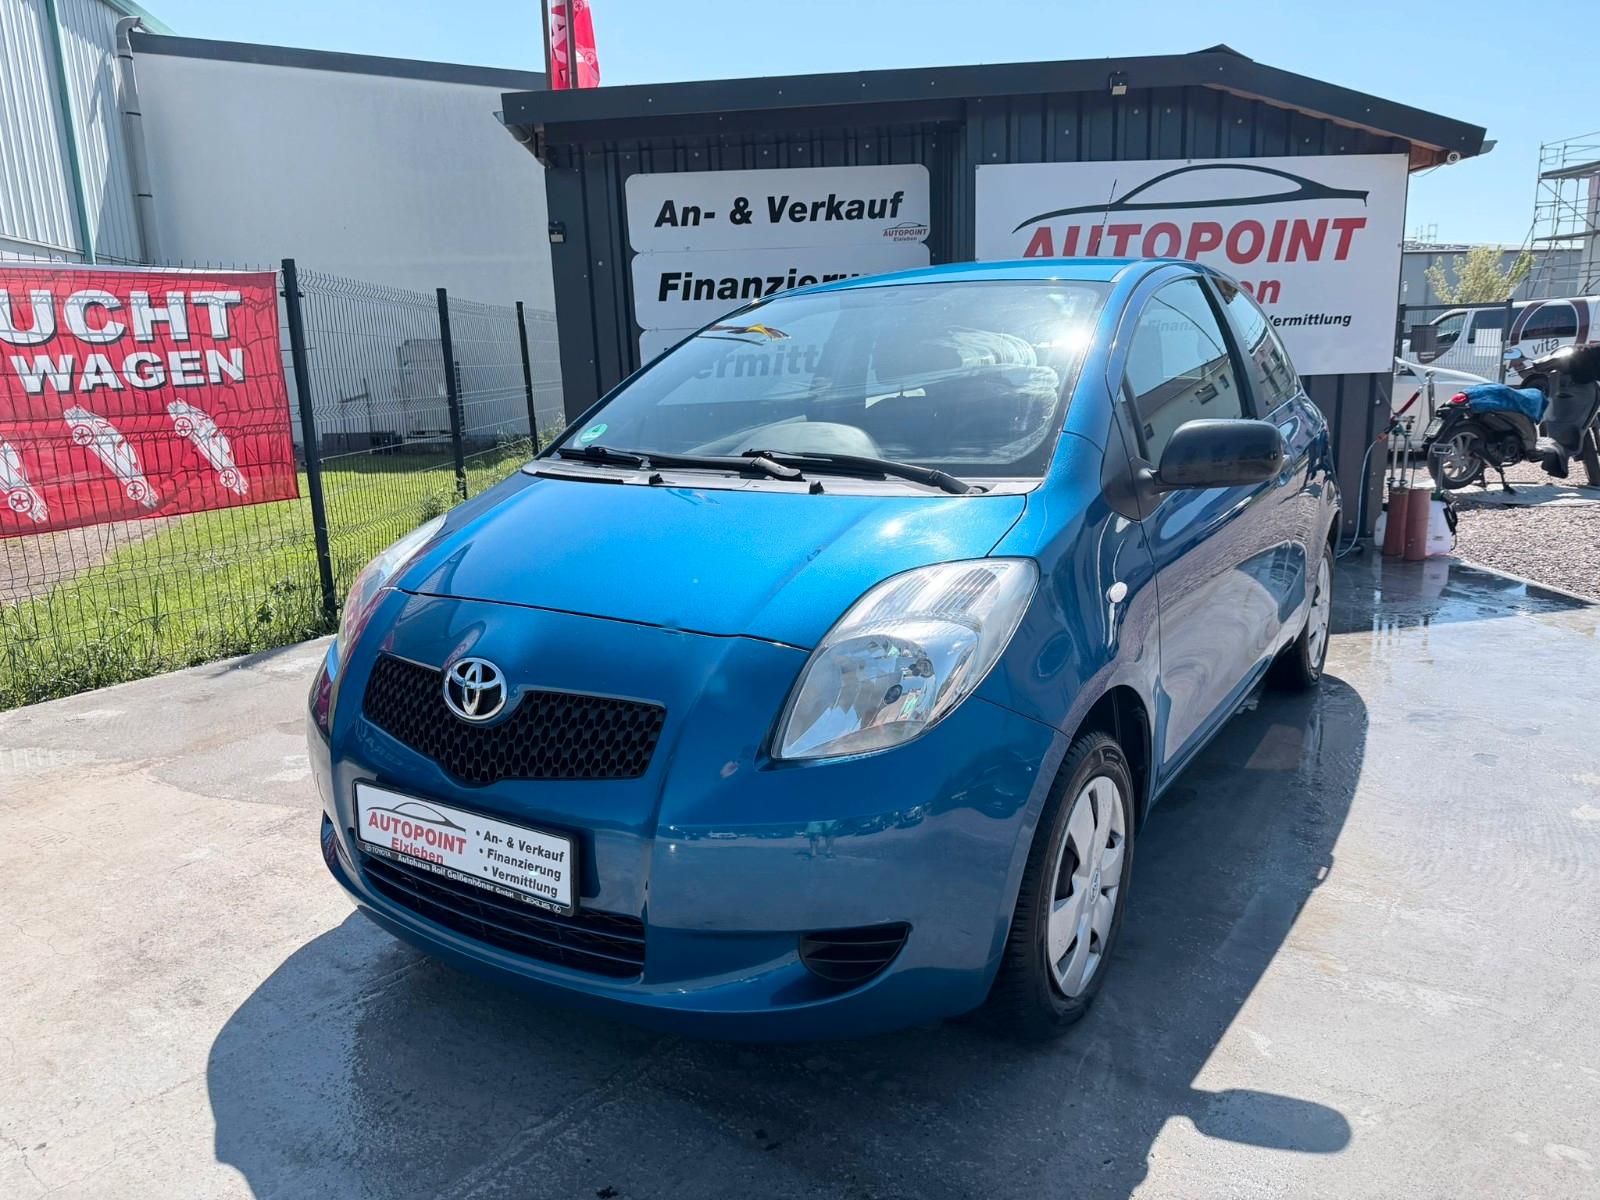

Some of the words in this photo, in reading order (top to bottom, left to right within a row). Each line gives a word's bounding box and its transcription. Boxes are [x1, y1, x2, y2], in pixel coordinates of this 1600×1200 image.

[654, 200, 716, 227] An-
[729, 196, 753, 225] &
[767, 191, 905, 223] Verkauf
[1023, 217, 1367, 264] AUTOPOINT
[658, 268, 862, 301] Finanzi
[1532, 337, 1560, 355] vita
[9, 347, 246, 394] WAGEN
[368, 811, 467, 855] AUTOPOINT
[484, 831, 503, 844] An-
[506, 836, 514, 849] &
[519, 840, 565, 862] Verkauf
[391, 837, 444, 865] Elxleben
[398, 854, 431, 871] Autohaus
[487, 848, 562, 881] Finanzierung
[492, 866, 558, 898] Vermittlung
